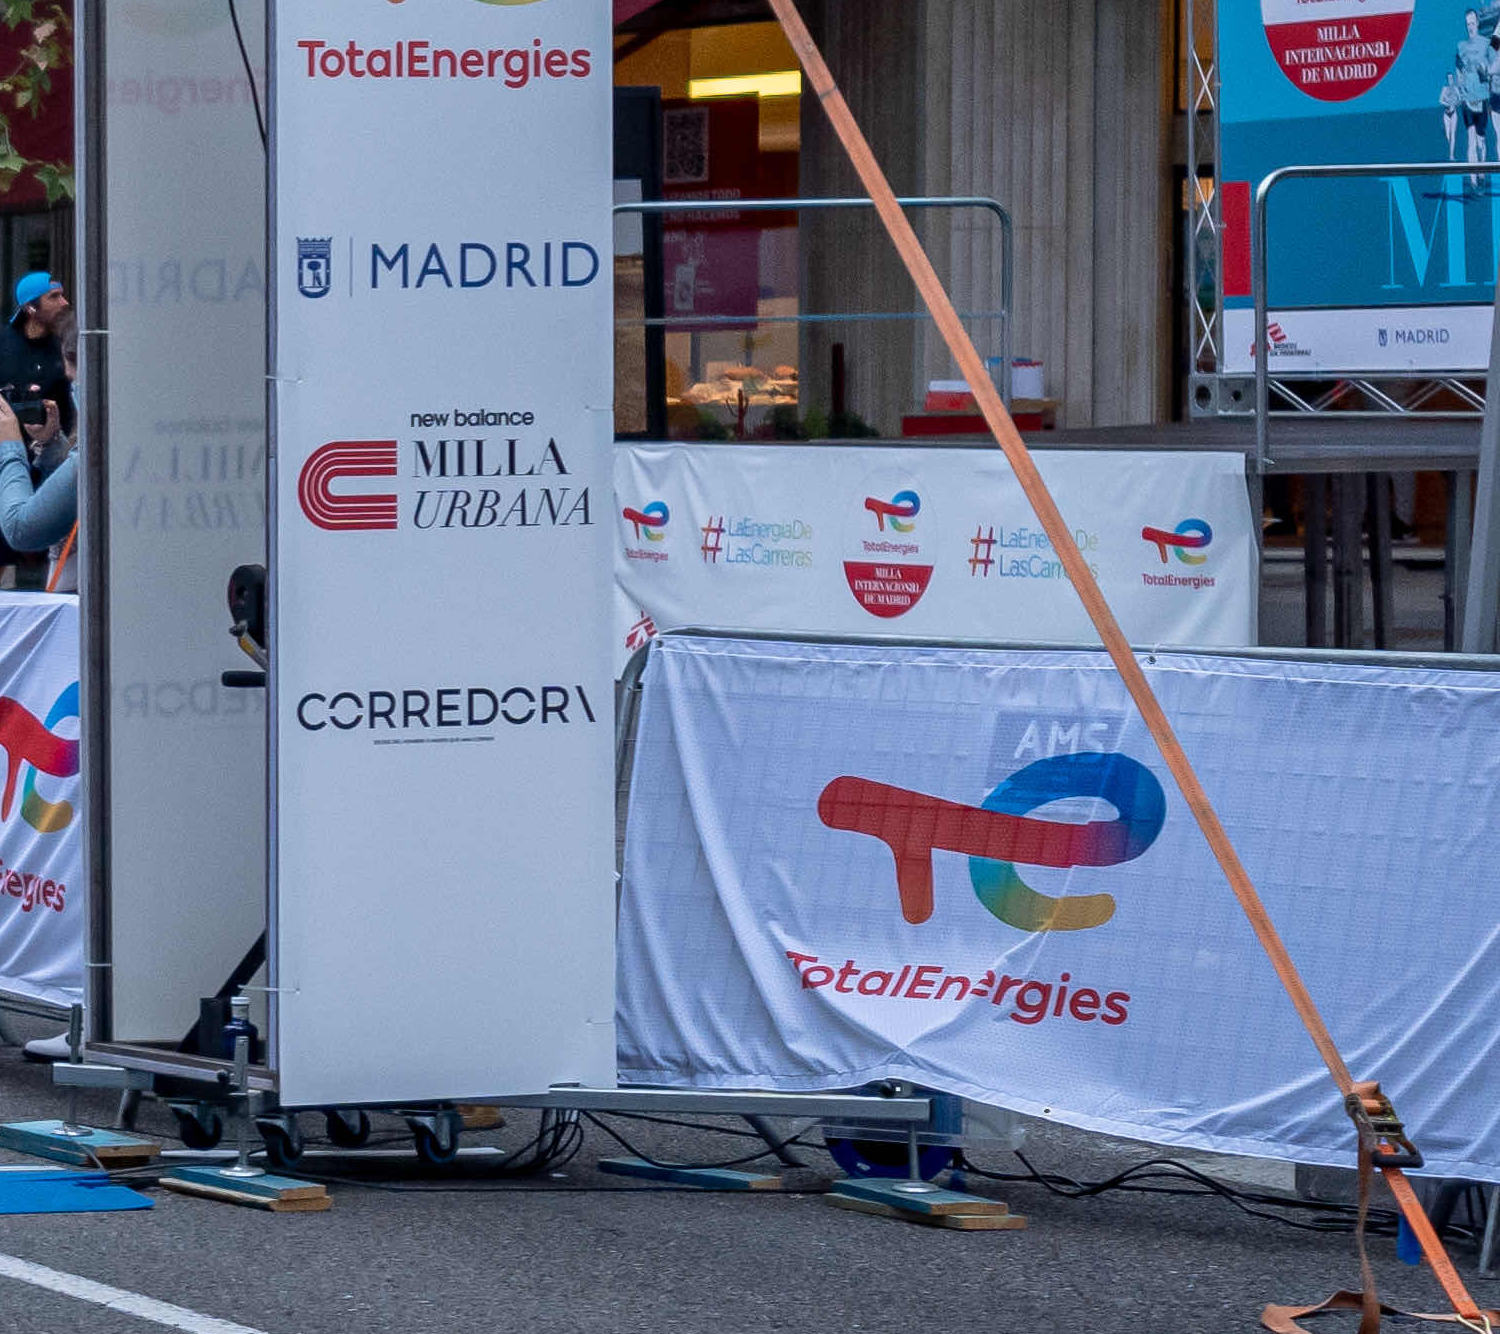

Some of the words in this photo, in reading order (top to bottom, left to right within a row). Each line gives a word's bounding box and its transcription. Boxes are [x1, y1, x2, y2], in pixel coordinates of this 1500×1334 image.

[1316, 24, 1361, 43] MILLA
[298, 40, 592, 89] TotalEnergies
[1301, 67, 1321, 83] DE
[1323, 62, 1379, 81] MADRID
[371, 242, 600, 290] MADRID
[1395, 329, 1450, 344] MADRID
[411, 411, 449, 427] new
[454, 408, 535, 427] balance
[413, 437, 570, 477] MILLA
[413, 486, 595, 530] URBANA
[863, 540, 920, 556] TotalEnergies
[875, 567, 902, 579] MILLA
[1143, 573, 1216, 590] TotalEnergies
[864, 593, 879, 605] DE
[880, 593, 911, 606] MADRID
